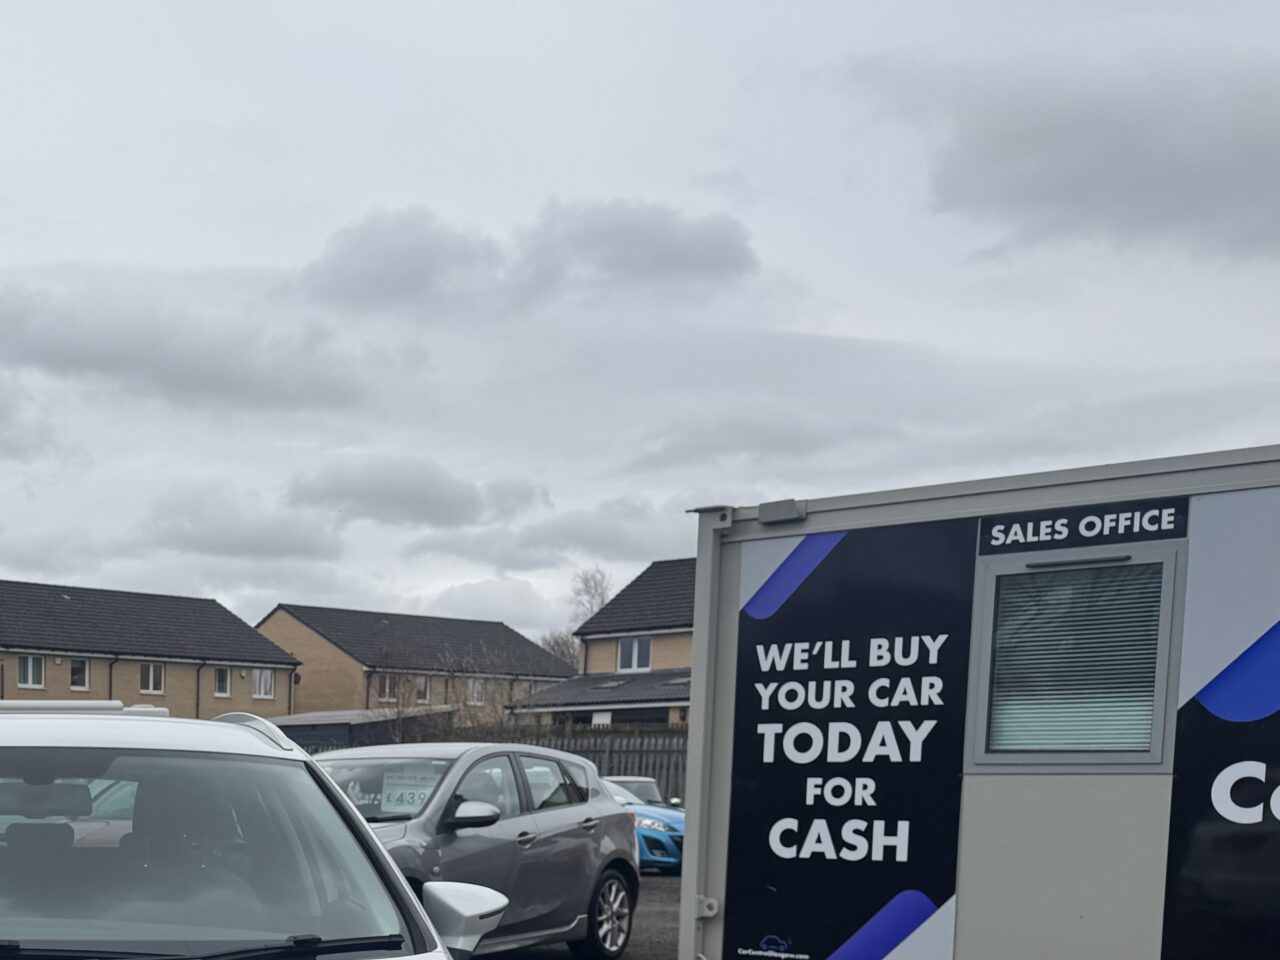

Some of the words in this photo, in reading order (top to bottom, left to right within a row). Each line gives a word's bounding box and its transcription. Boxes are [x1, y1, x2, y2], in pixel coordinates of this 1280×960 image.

[990, 518, 1069, 546] SALES
[1078, 507, 1176, 537] OFFICE
[755, 639, 857, 672] WE’LL
[868, 634, 949, 668] BUY
[754, 679, 856, 711] YOUR
[867, 676, 944, 708] CAR
[756, 719, 938, 764] TODAY
[805, 776, 877, 807] FOR
[768, 817, 910, 862] CASH
